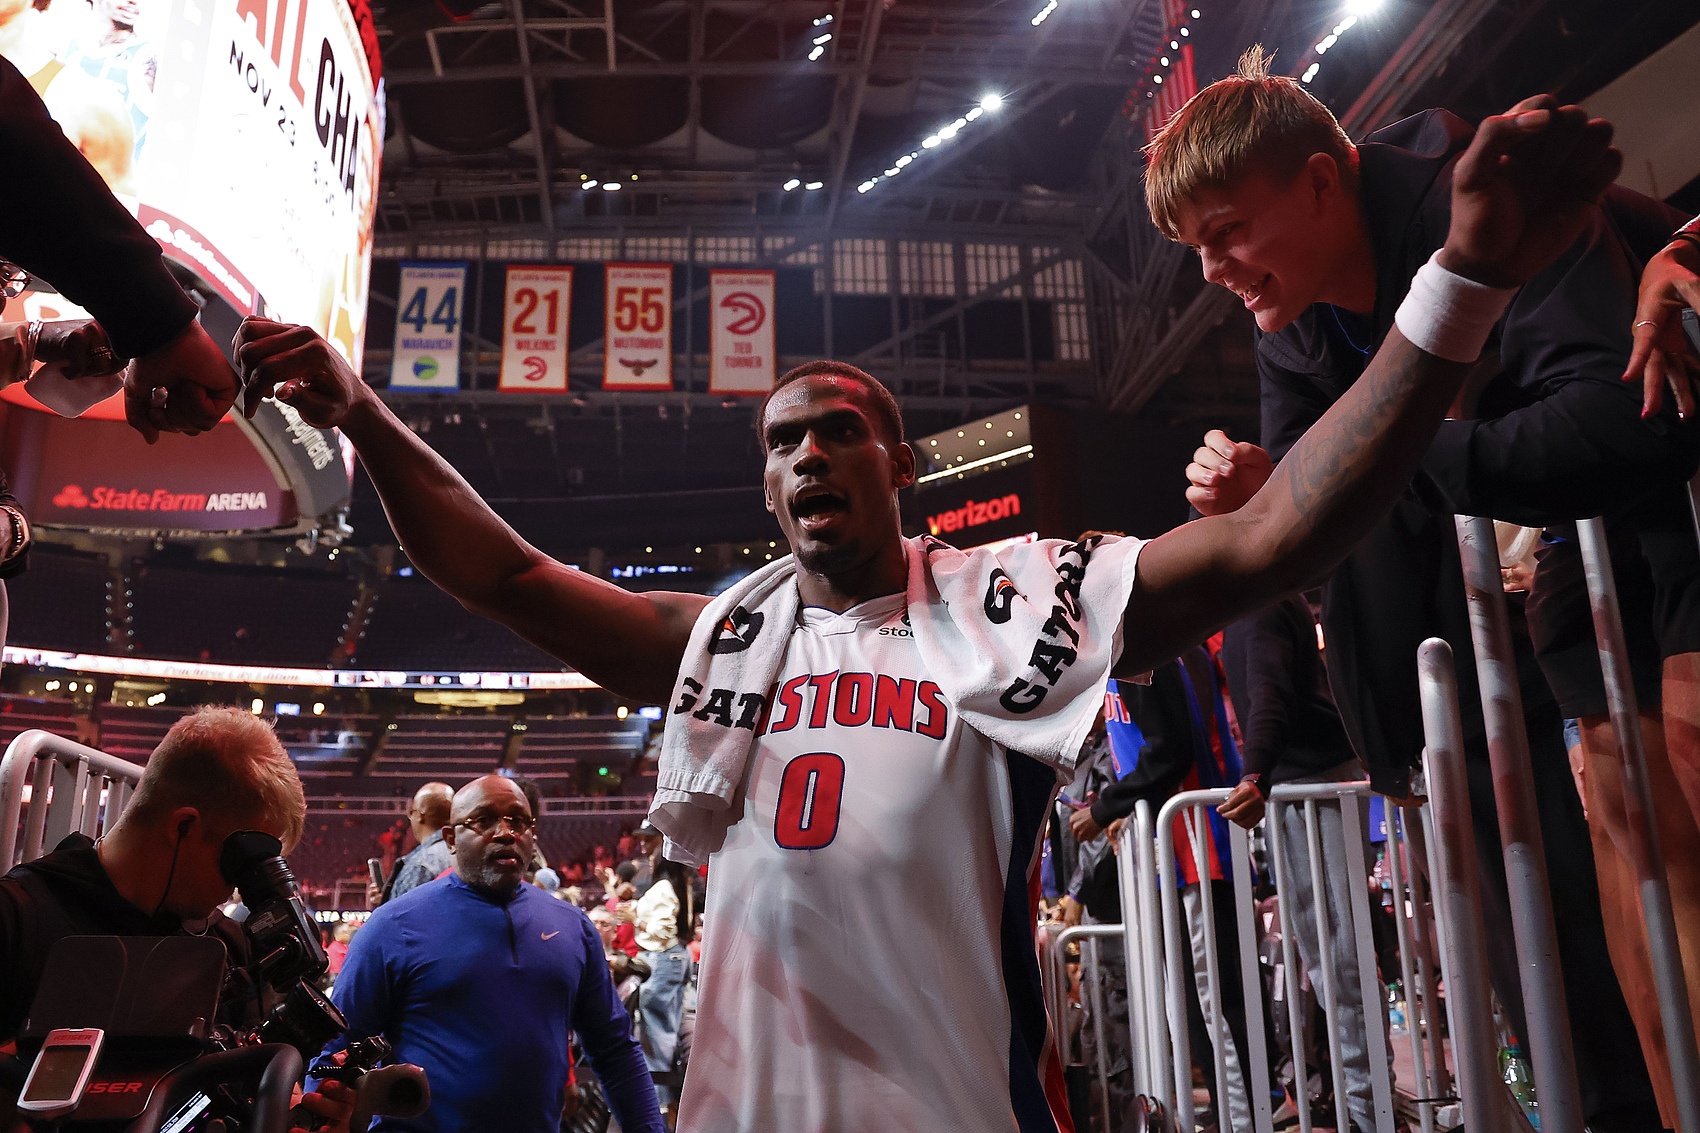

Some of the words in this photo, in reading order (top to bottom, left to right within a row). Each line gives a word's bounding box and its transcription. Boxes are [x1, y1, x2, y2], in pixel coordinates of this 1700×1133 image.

[230, 40, 271, 107] NOV
[314, 37, 359, 213] CHA
[401, 286, 457, 334] 44
[512, 286, 559, 335] 21
[614, 285, 665, 334] 55
[206, 491, 268, 511] ARENA
[926, 493, 1021, 535] verizon
[754, 669, 949, 741] ISTONS
[773, 751, 846, 851] 0
[84, 1082, 143, 1094] ISER
